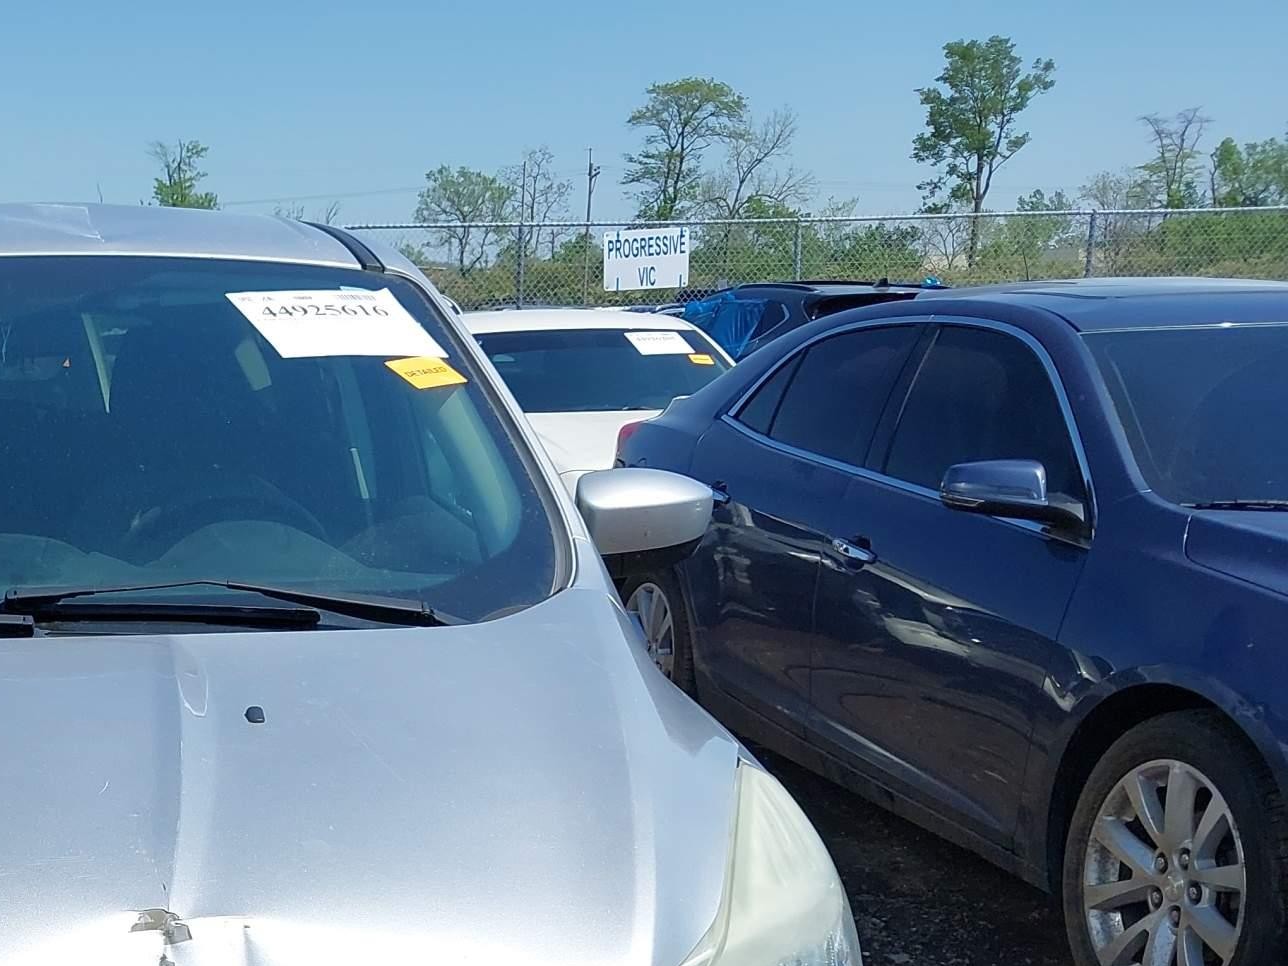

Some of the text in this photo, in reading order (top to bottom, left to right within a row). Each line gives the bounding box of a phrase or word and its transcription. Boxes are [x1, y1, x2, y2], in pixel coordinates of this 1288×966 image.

[607, 234, 686, 260] PROGRESSIVE
[638, 266, 657, 287] VIC
[262, 304, 389, 318] 44925616
